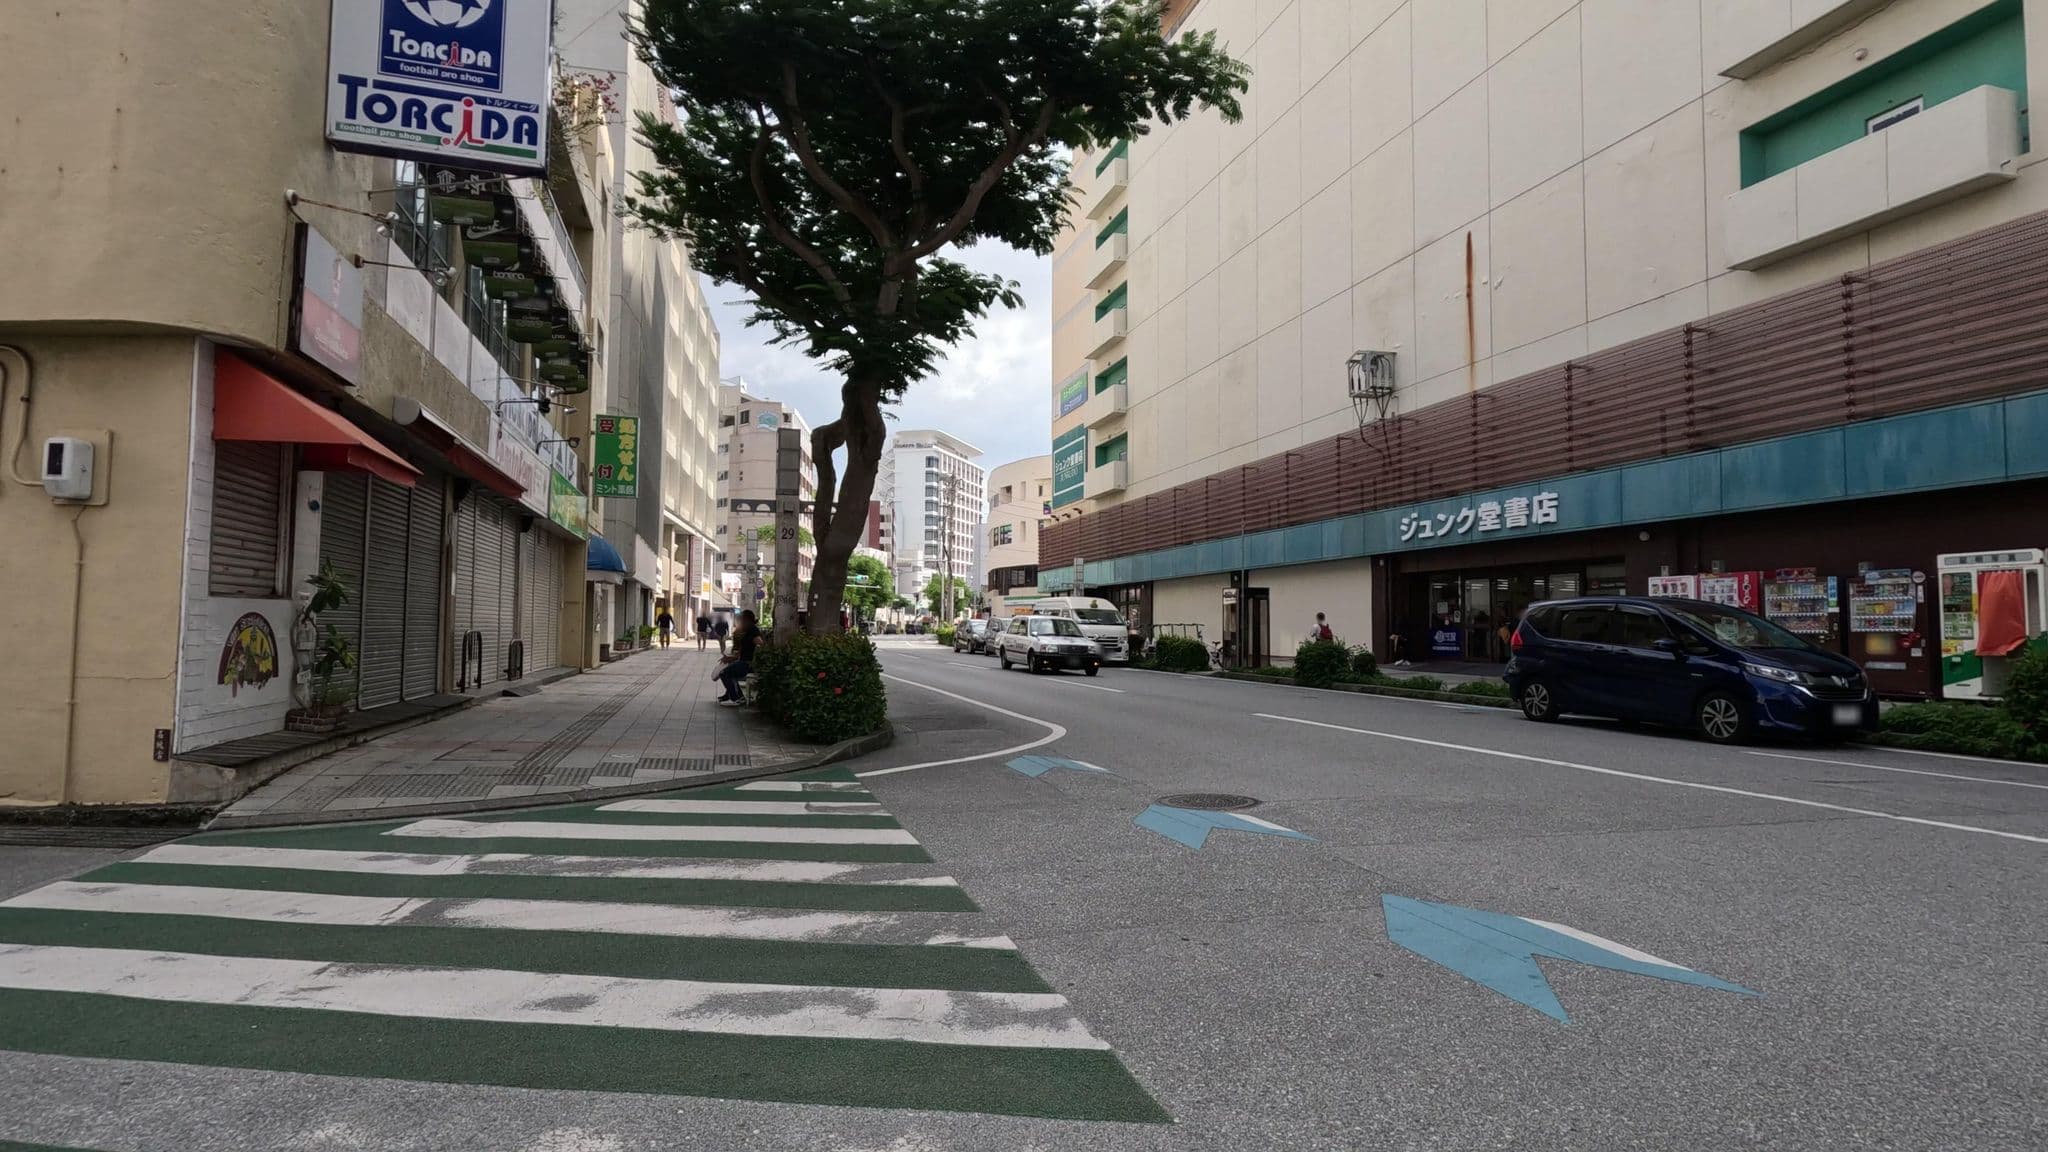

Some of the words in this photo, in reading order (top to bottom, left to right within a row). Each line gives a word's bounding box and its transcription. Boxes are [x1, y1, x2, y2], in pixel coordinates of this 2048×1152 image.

[400, 62, 438, 77] football
[441, 69, 458, 81] pro
[460, 71, 484, 84] shop
[339, 122, 378, 136] football
[380, 127, 396, 139] pro
[398, 128, 422, 143] shop
[617, 417, 636, 482] 処方せん
[1055, 449, 1083, 473] ジュンク堂書店
[596, 483, 634, 495] ミント薬局
[1400, 491, 1559, 541] ジュンク堂書店
[782, 528, 794, 540] 29
